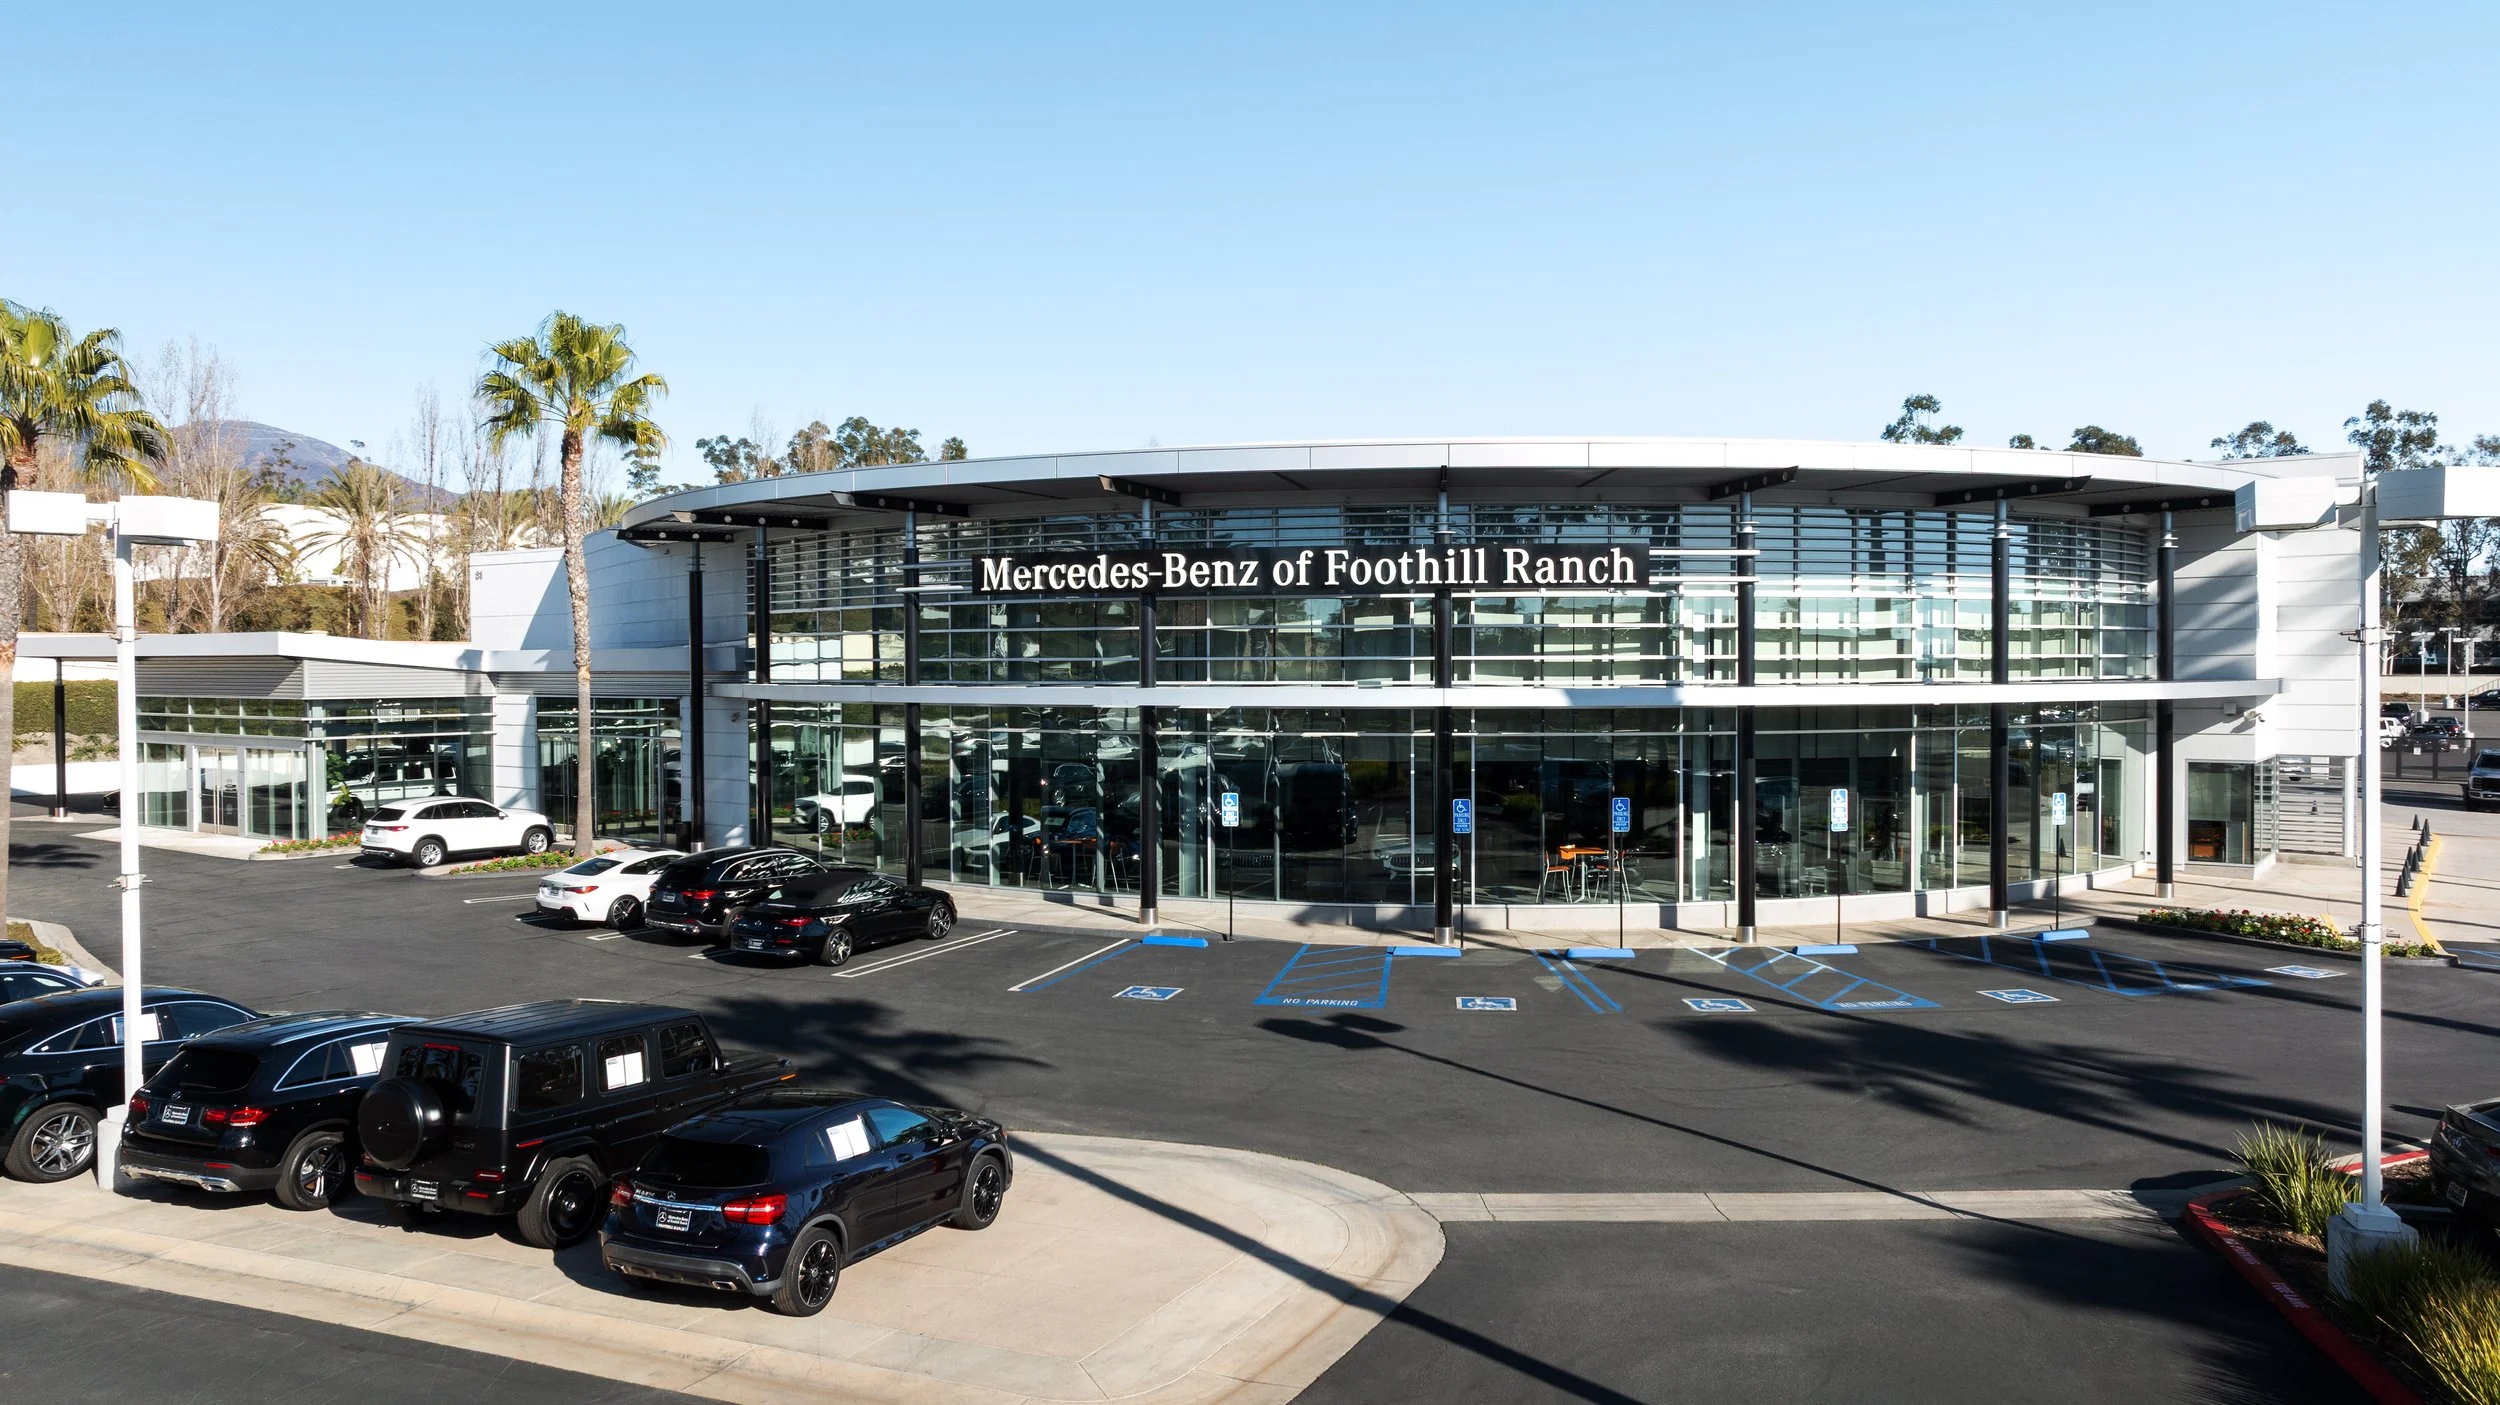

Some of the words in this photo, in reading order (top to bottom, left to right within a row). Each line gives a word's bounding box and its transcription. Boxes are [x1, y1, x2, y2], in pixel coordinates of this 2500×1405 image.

[980, 552, 1260, 592] Mercedes-Benz
[1272, 549, 1314, 586] of
[1324, 547, 1489, 586] Foothill
[1502, 547, 1637, 584] Ranch
[1305, 998, 1359, 1006] PARKING
